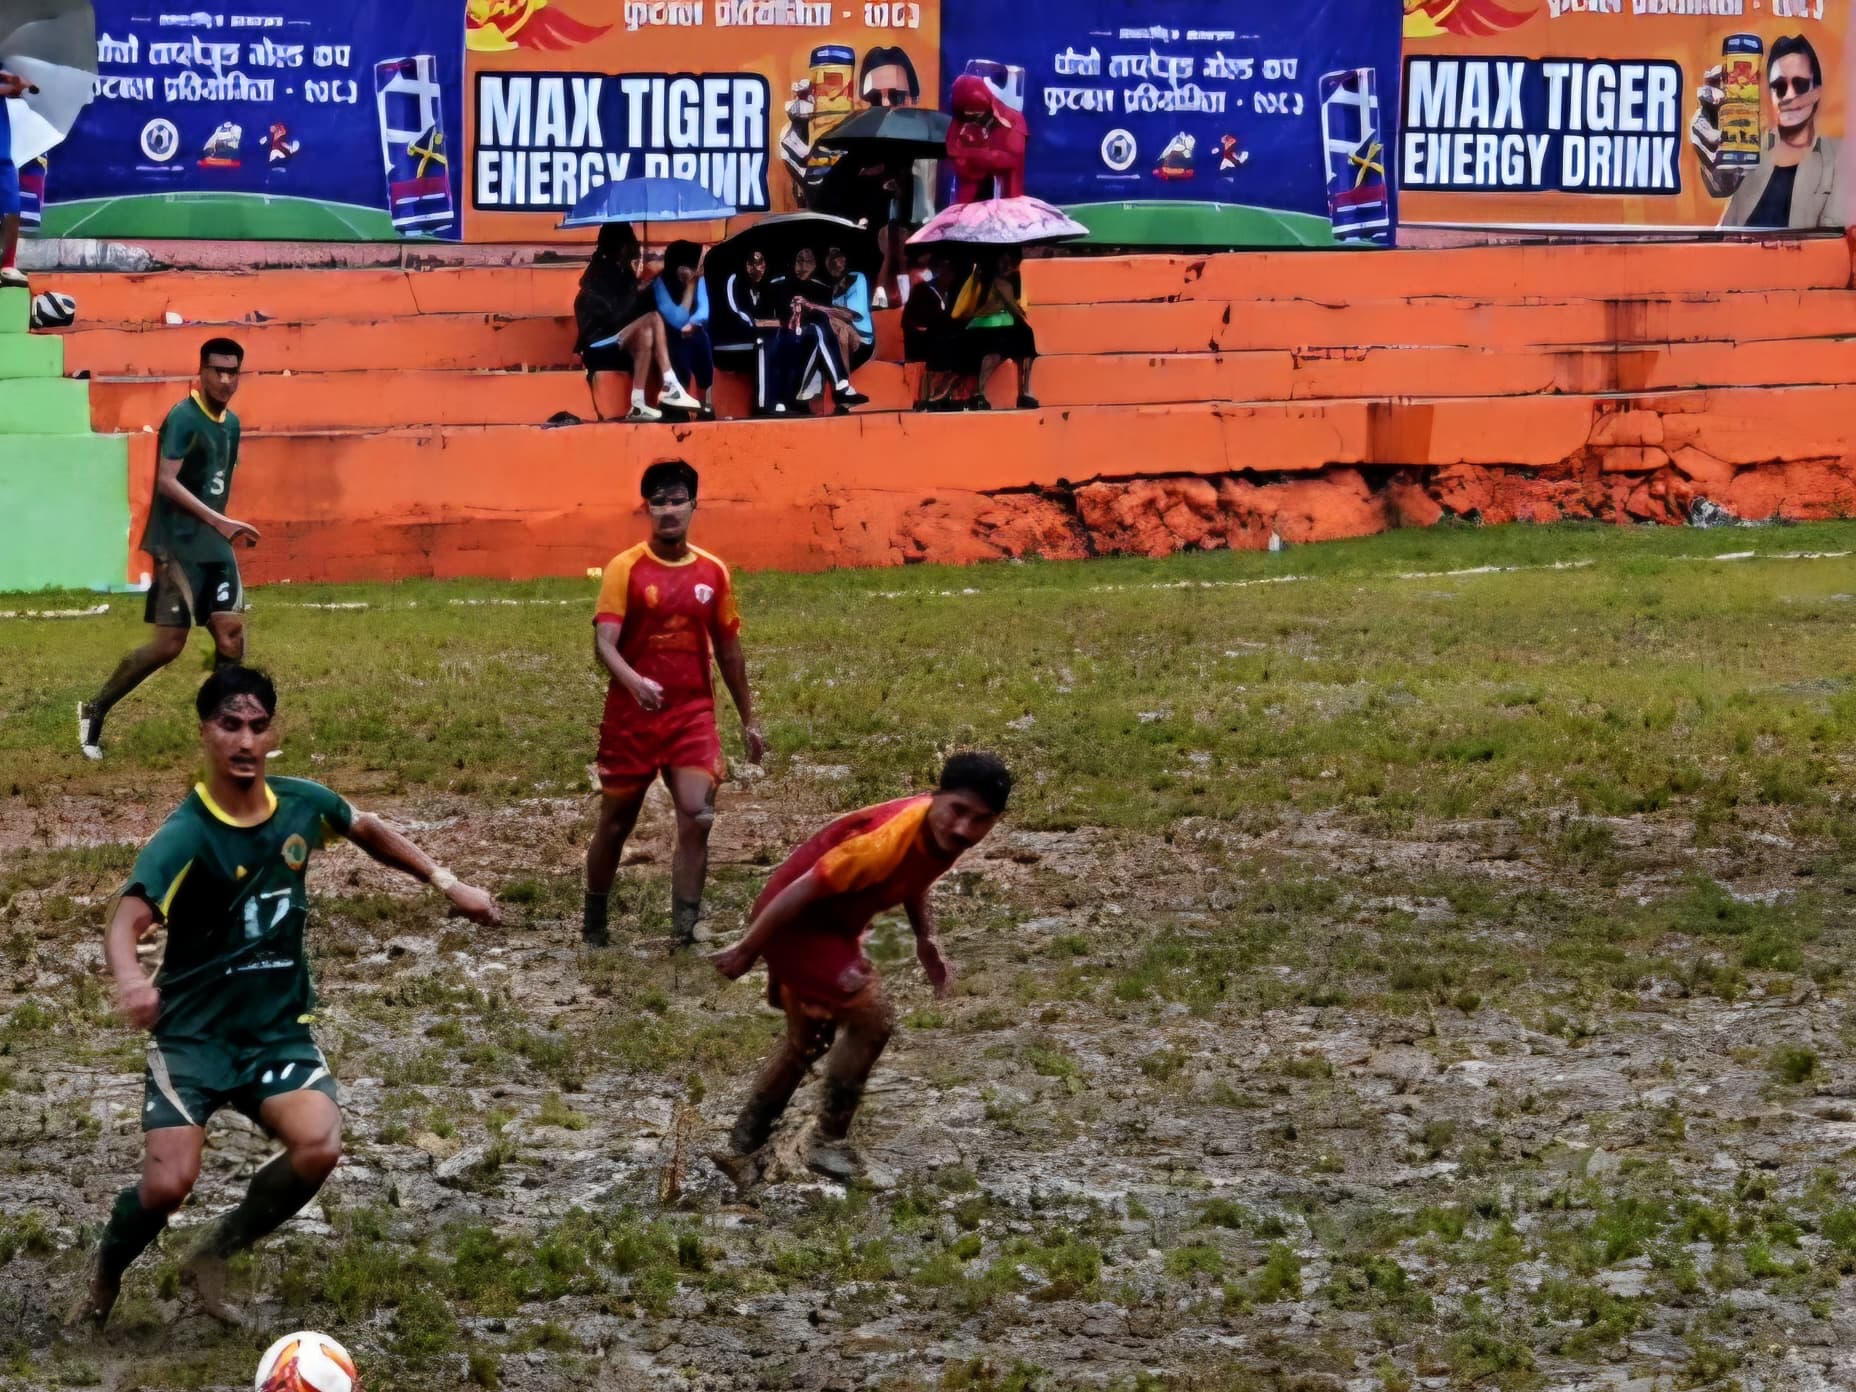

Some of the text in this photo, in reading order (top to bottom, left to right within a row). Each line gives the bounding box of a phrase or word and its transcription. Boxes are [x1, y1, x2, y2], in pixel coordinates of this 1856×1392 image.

[480, 76, 765, 148] MAX TIGER
[1407, 61, 1678, 132] MAX TIGER
[477, 150, 631, 205] ENERGY
[1404, 132, 1676, 189] ENERGY DRINK
[244, 887, 293, 940] 17
